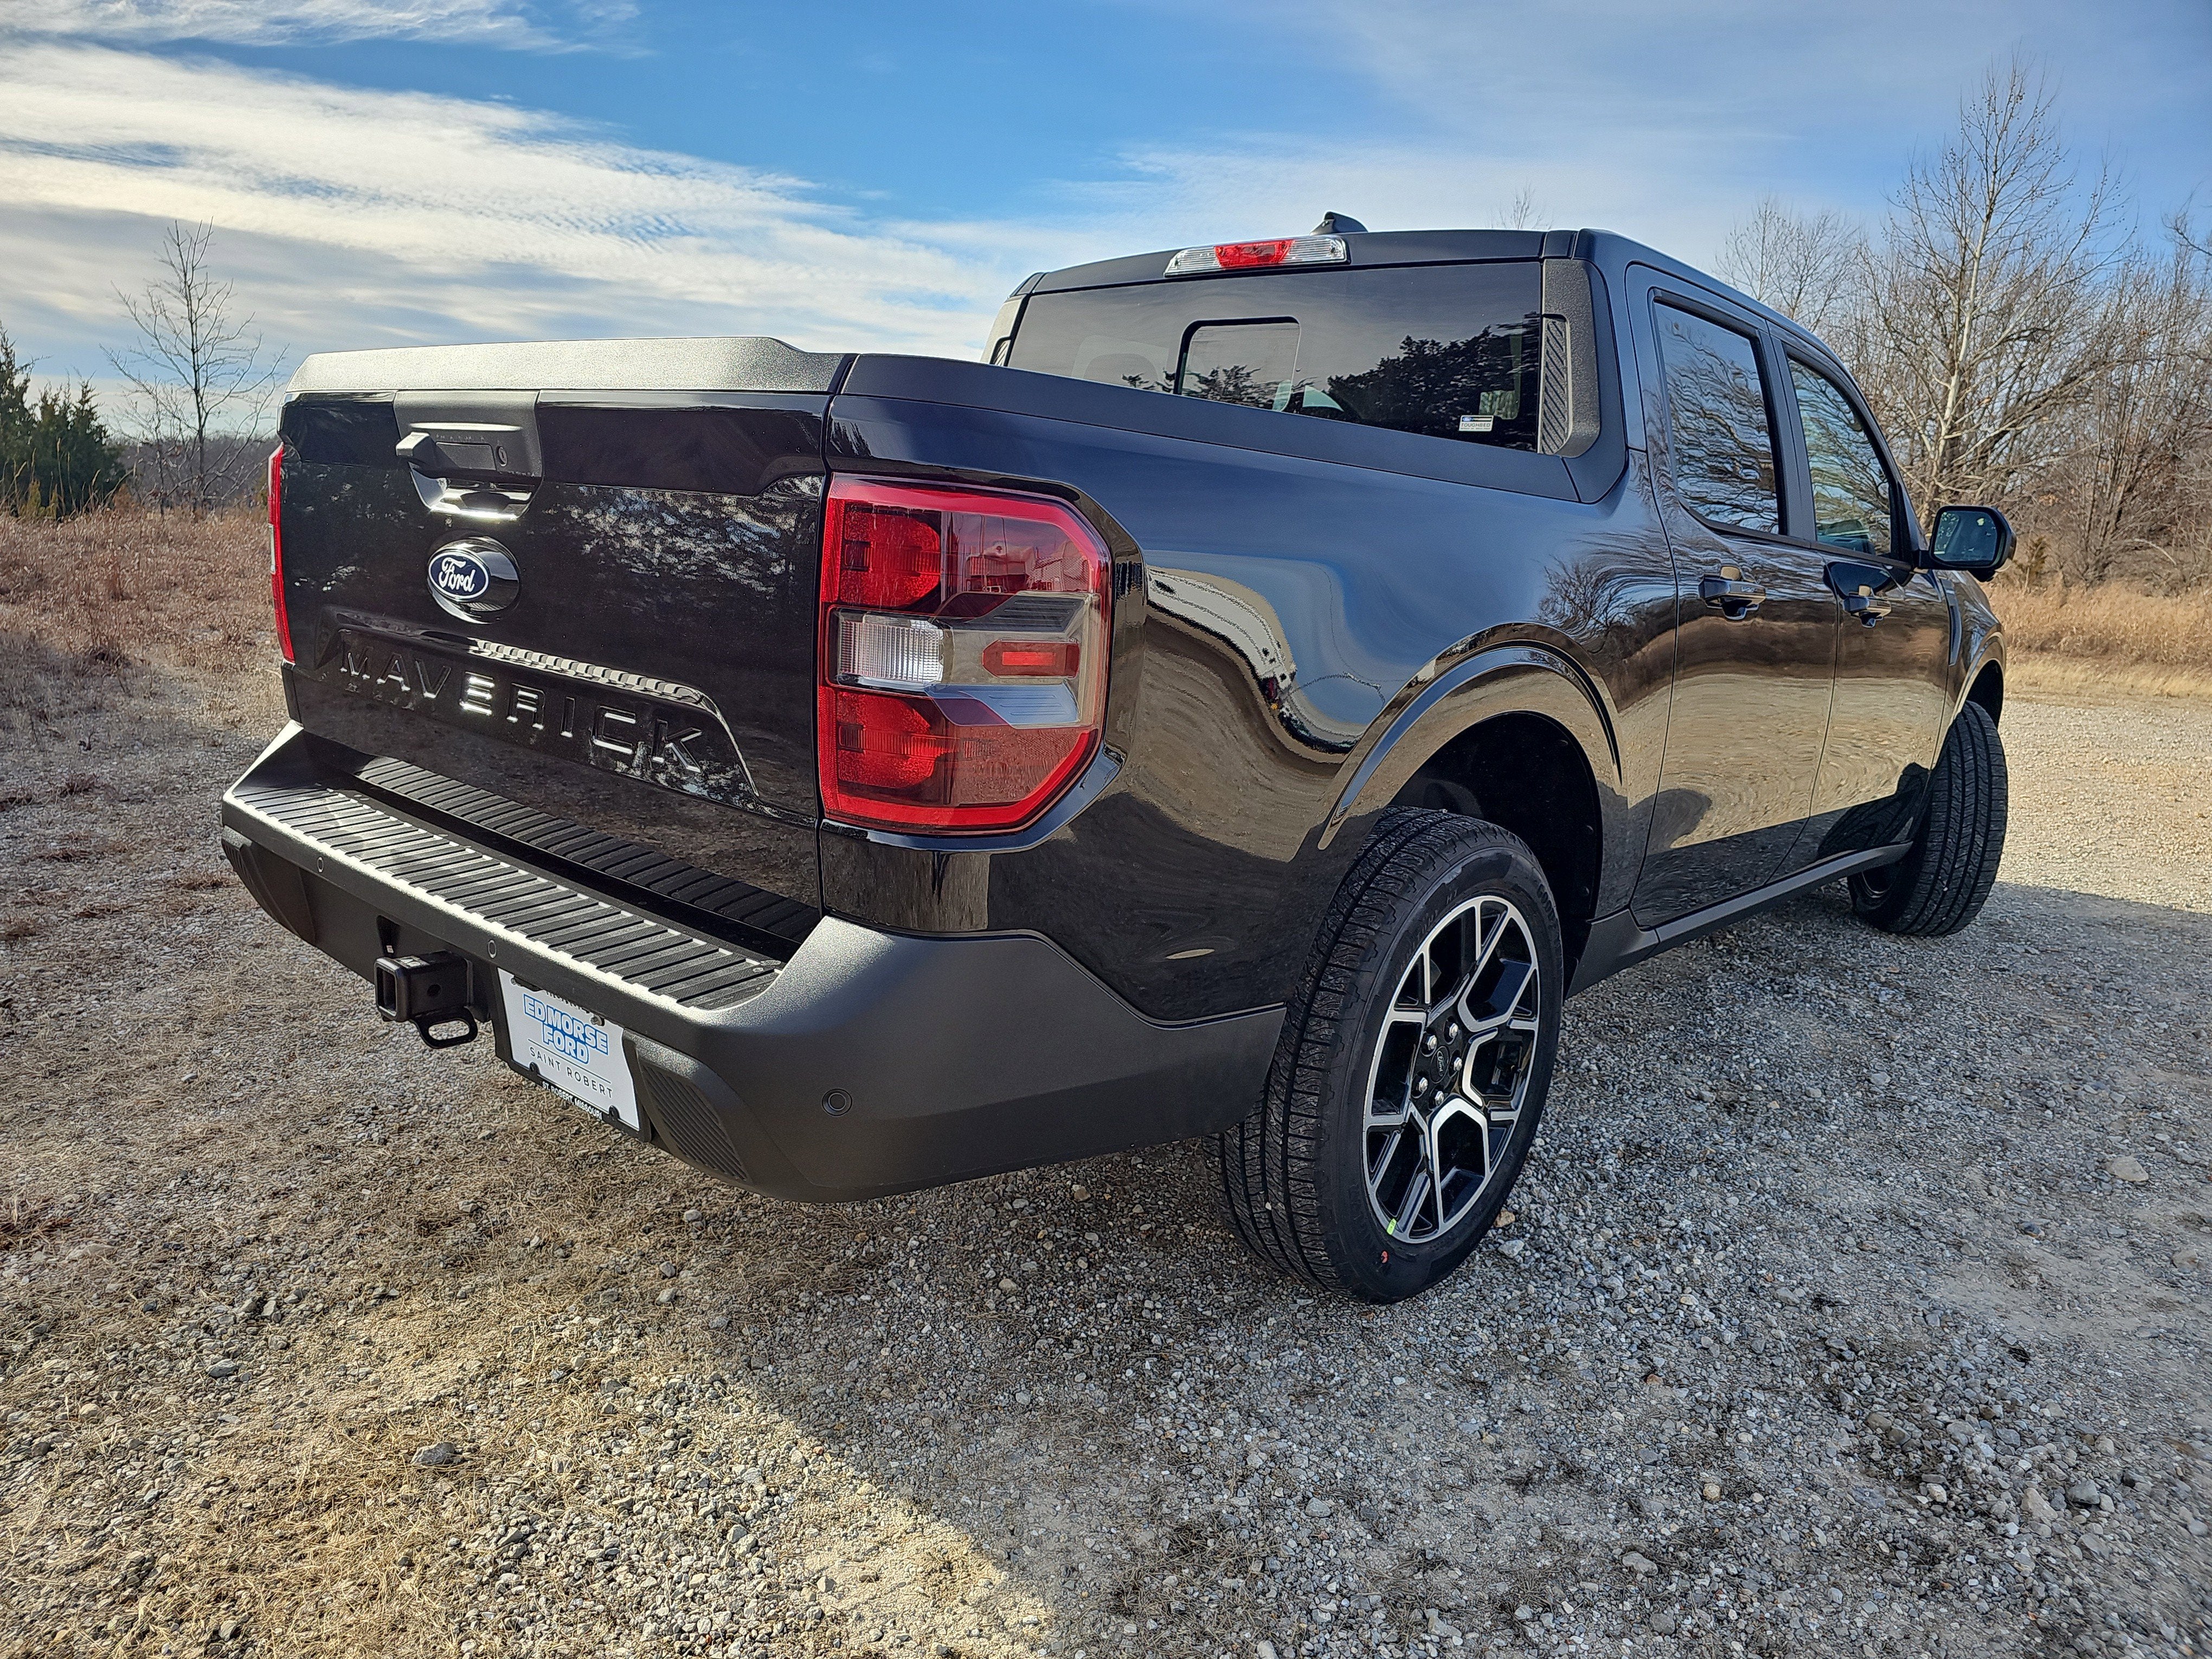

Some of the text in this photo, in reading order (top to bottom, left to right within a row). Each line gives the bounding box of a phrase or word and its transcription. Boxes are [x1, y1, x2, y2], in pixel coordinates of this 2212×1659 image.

[438, 557, 476, 592] Ford
[340, 642, 703, 773] MAVERICK
[524, 994, 546, 1024] ED
[545, 1005, 609, 1056] MORSE
[543, 1022, 589, 1064] FORD
[530, 1047, 613, 1099] SAINT ROBERT
[574, 1098, 602, 1121] MISSOURI
